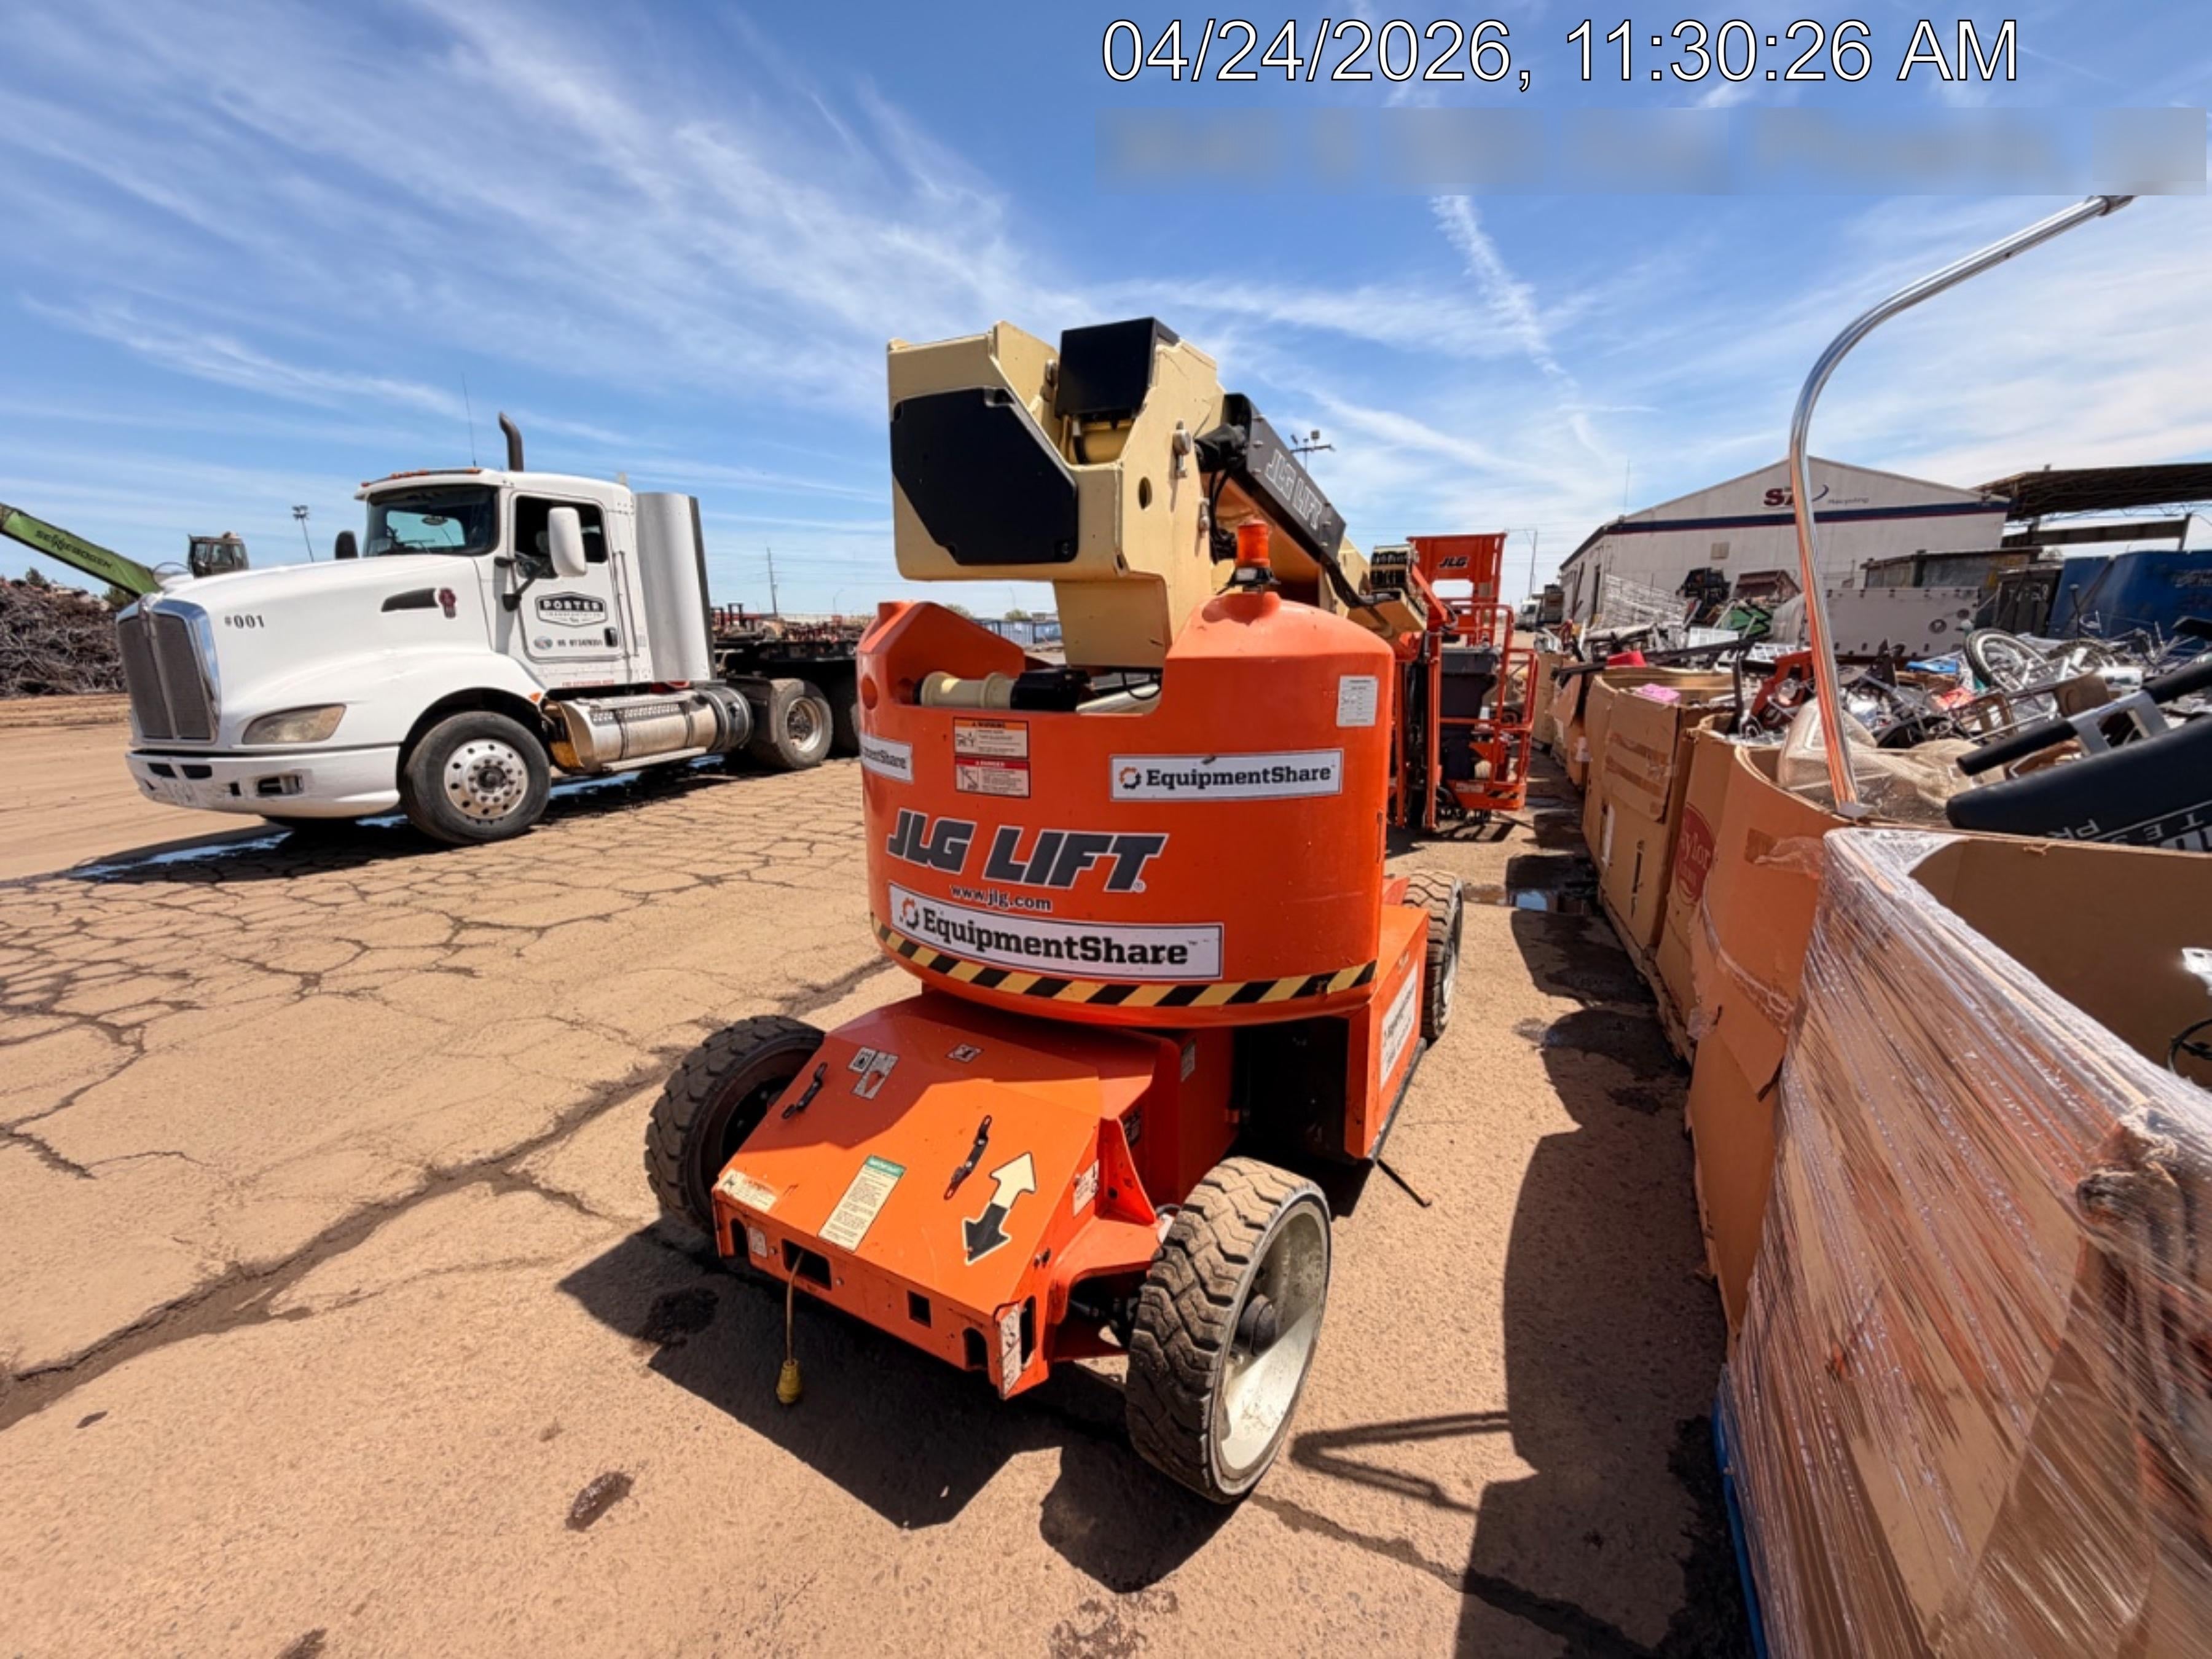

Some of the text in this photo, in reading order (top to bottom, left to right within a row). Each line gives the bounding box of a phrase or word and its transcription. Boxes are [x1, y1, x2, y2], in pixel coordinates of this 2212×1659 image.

[1438, 555, 1470, 569] JLG
[224, 613, 264, 629] #001
[1146, 766, 1332, 790] EquipmentShare
[886, 807, 977, 875] JLG
[950, 885, 1053, 912] www.jlg.com
[923, 907, 1188, 965] EquipmentShare
